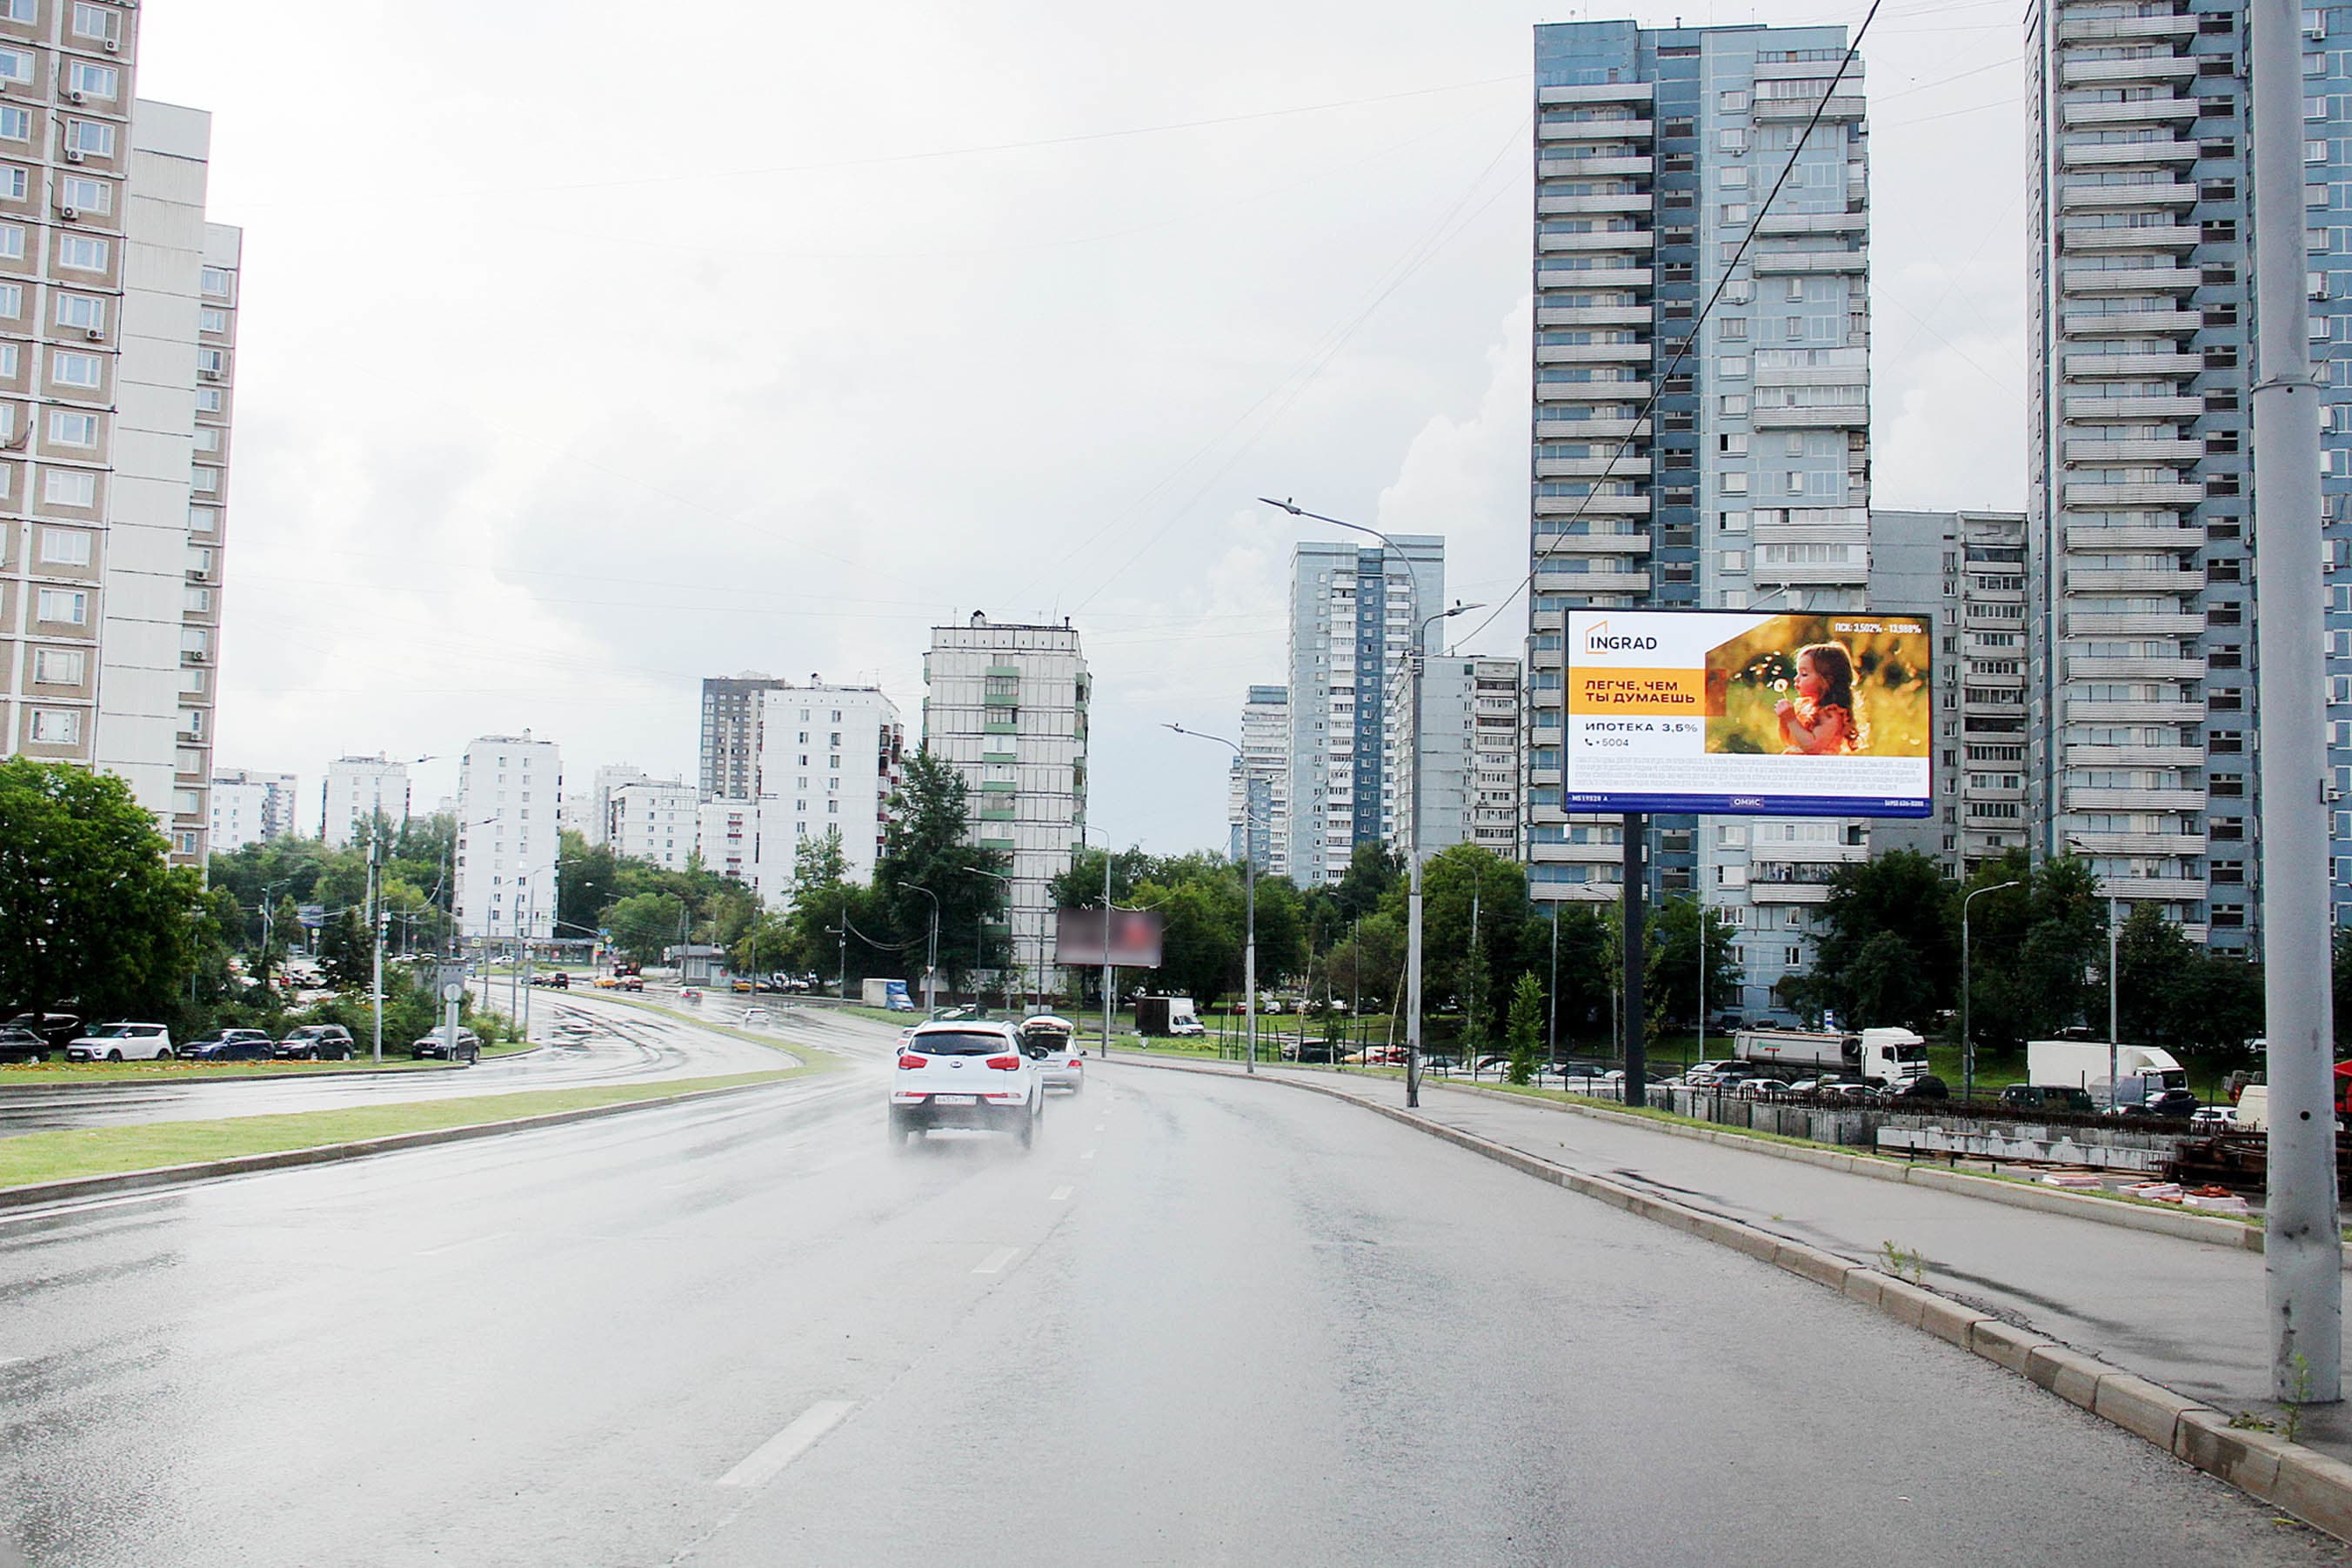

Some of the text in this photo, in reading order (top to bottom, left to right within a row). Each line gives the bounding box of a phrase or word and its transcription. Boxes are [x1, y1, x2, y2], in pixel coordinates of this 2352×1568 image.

[1590, 636, 1658, 651] INGRAD
[1585, 680, 1678, 691] ЛЕГЧЕ, ЧЕМ
[1586, 692, 1695, 704] ТЫ ДУМАЕШЬ
[1585, 723, 1698, 733] ИПОТЕКА 3,5%
